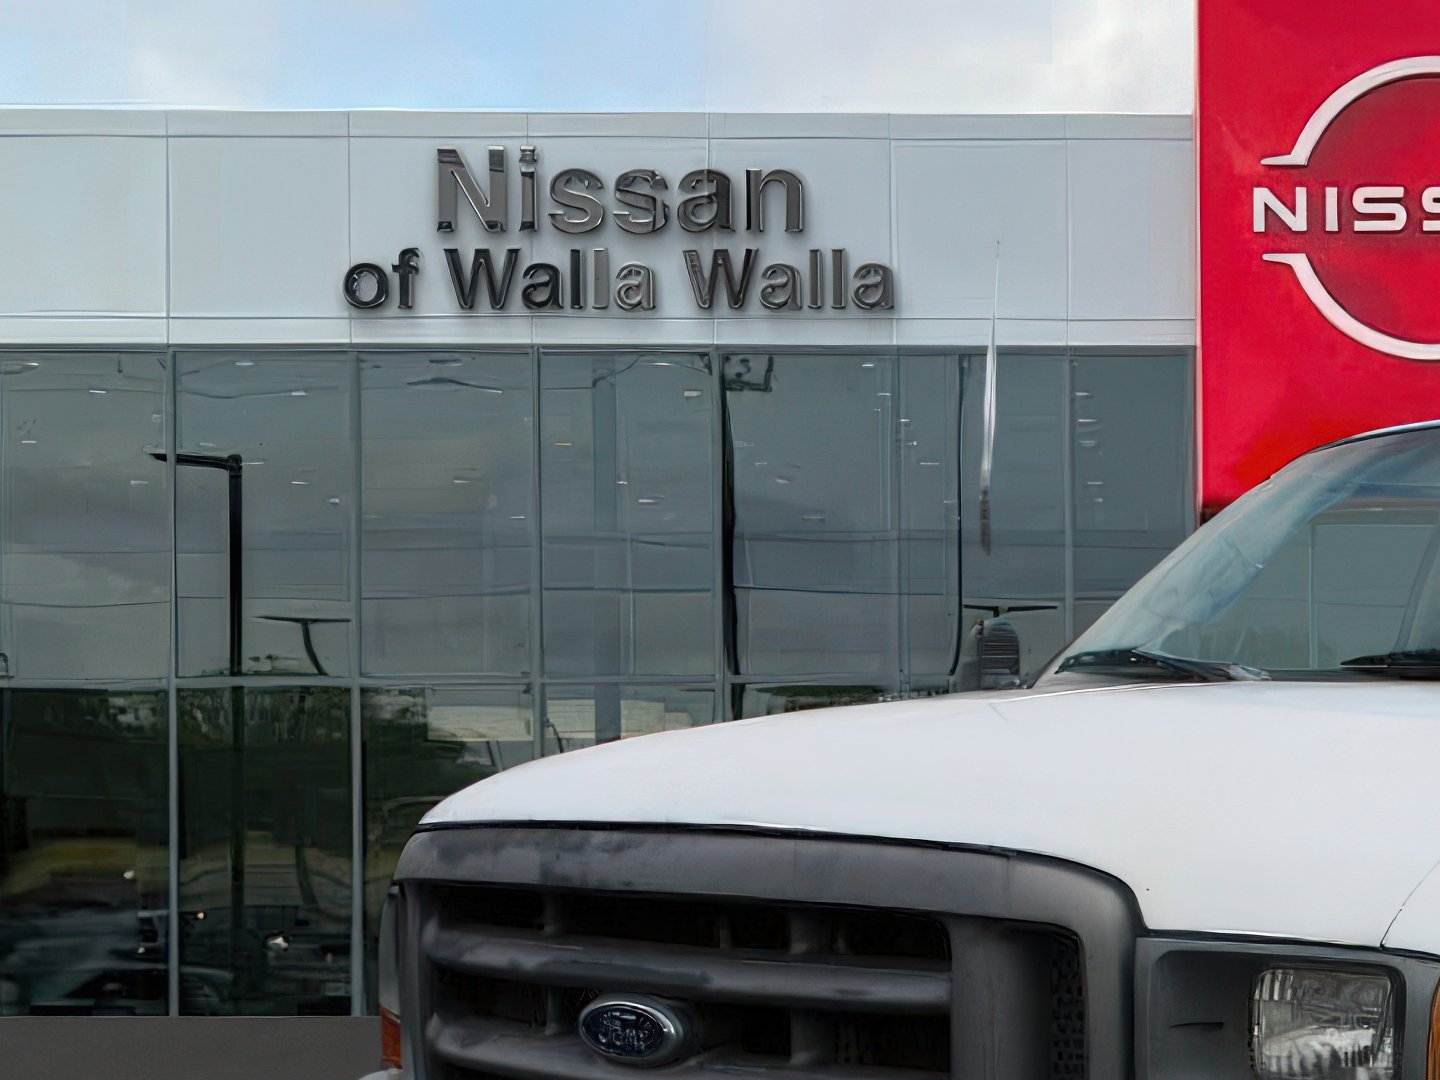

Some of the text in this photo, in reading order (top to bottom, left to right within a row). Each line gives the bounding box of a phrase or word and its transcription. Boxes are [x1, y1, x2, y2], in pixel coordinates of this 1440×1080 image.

[436, 145, 806, 235] Nissan
[342, 247, 895, 311] of Walla Walla
